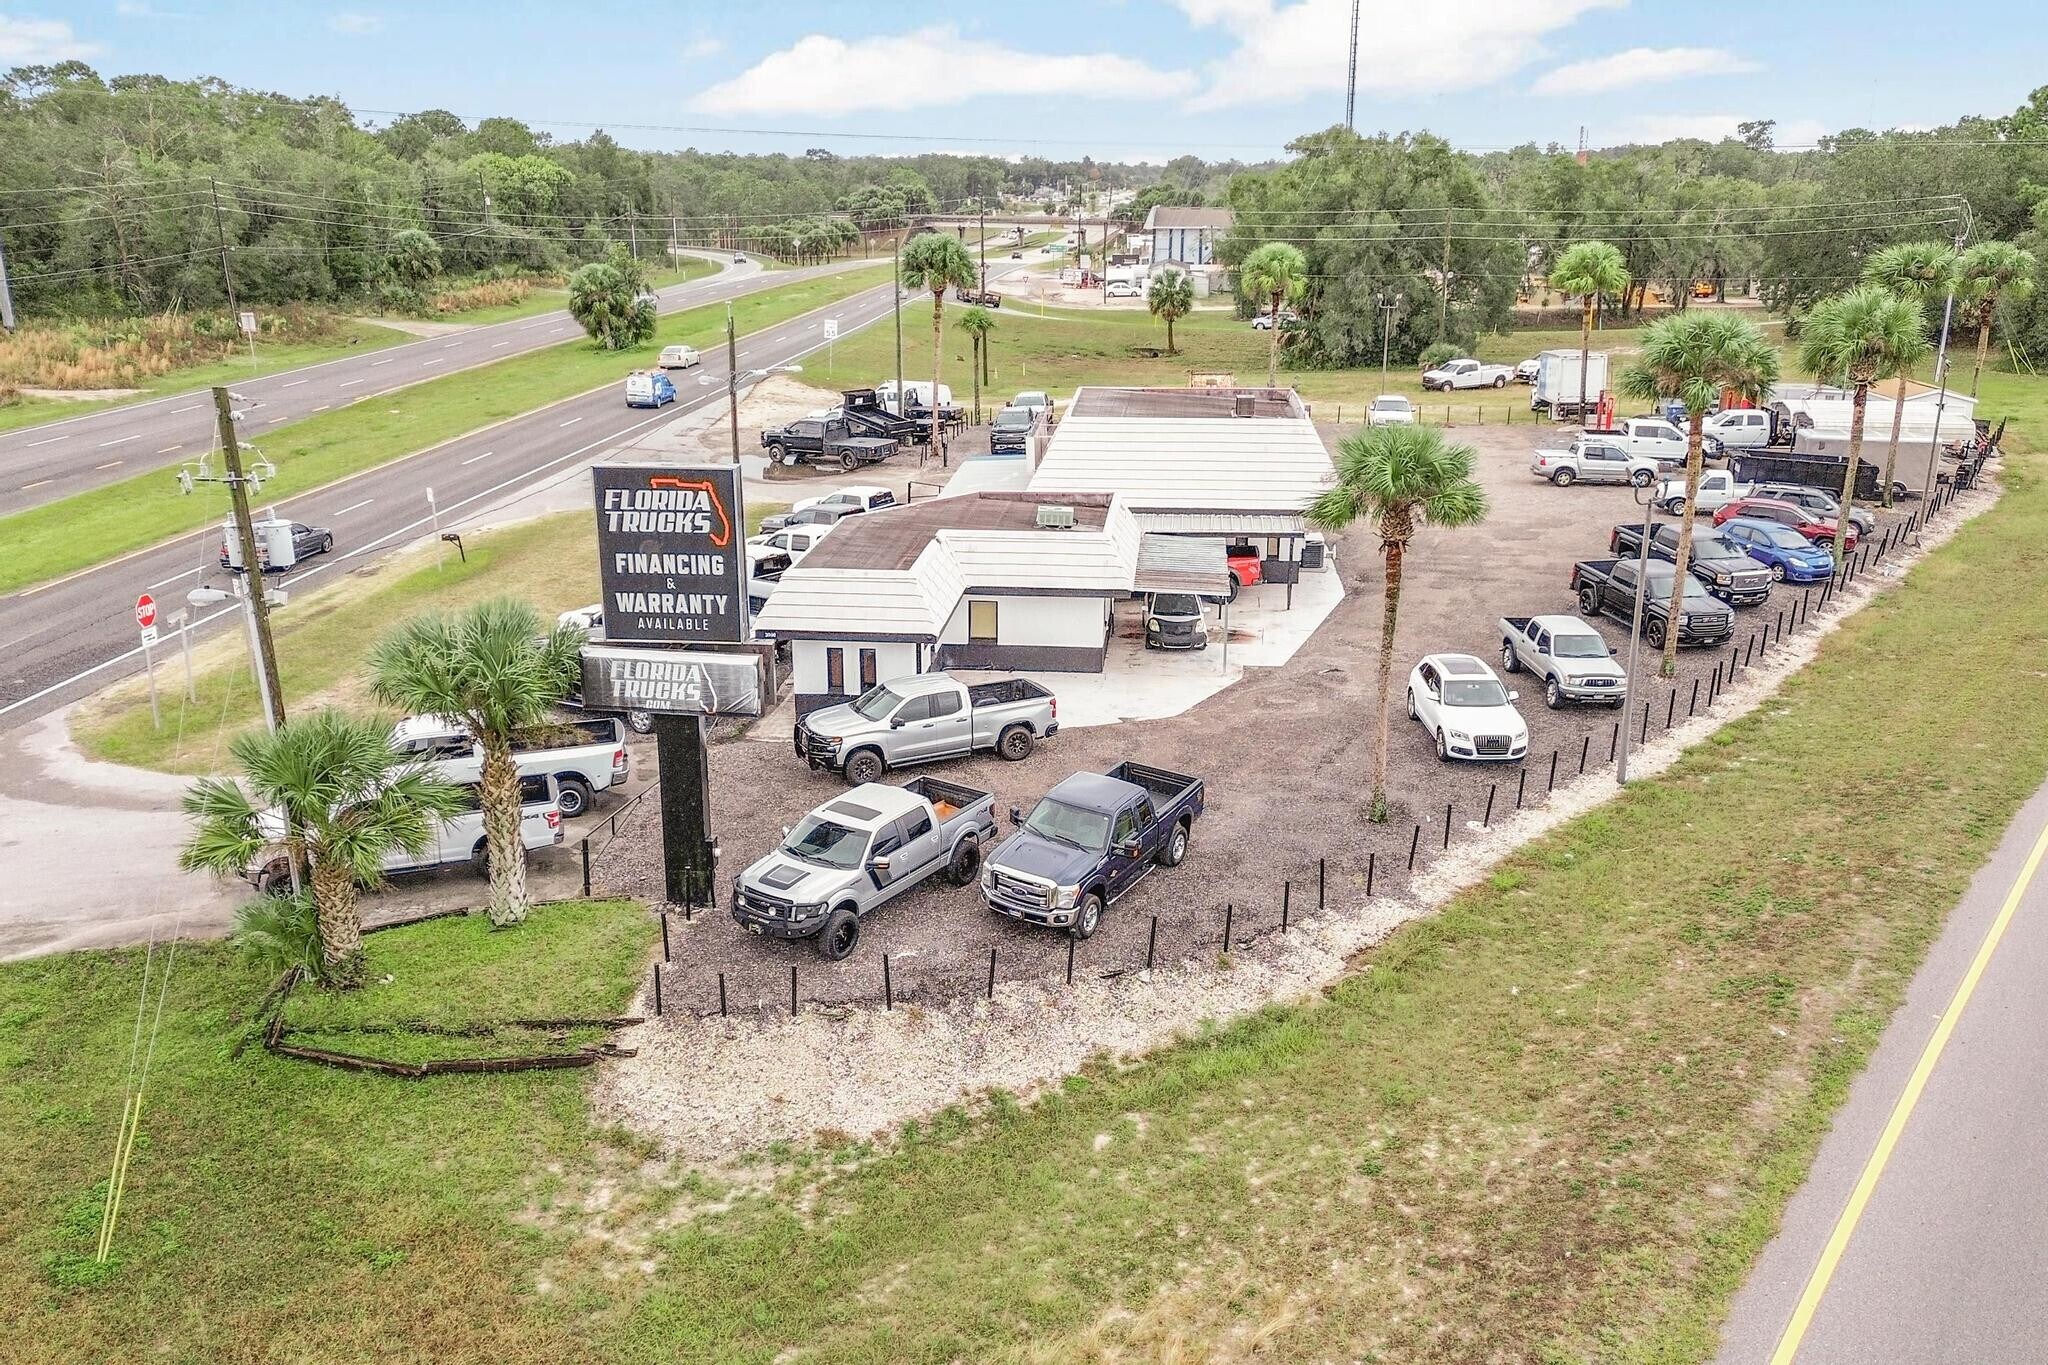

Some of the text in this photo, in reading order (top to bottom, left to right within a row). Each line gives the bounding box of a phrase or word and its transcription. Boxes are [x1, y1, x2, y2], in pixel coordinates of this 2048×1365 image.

[604, 489, 711, 511] FLORIDA
[604, 511, 711, 533] TRUCKS
[615, 553, 724, 576] FINANCING
[666, 578, 676, 589] &
[137, 602, 154, 619] STOP
[615, 592, 728, 615] WARRANTY
[638, 617, 709, 630] AVAILABLE
[610, 660, 701, 682] FLORIDA
[610, 680, 701, 701] TRUCKS
